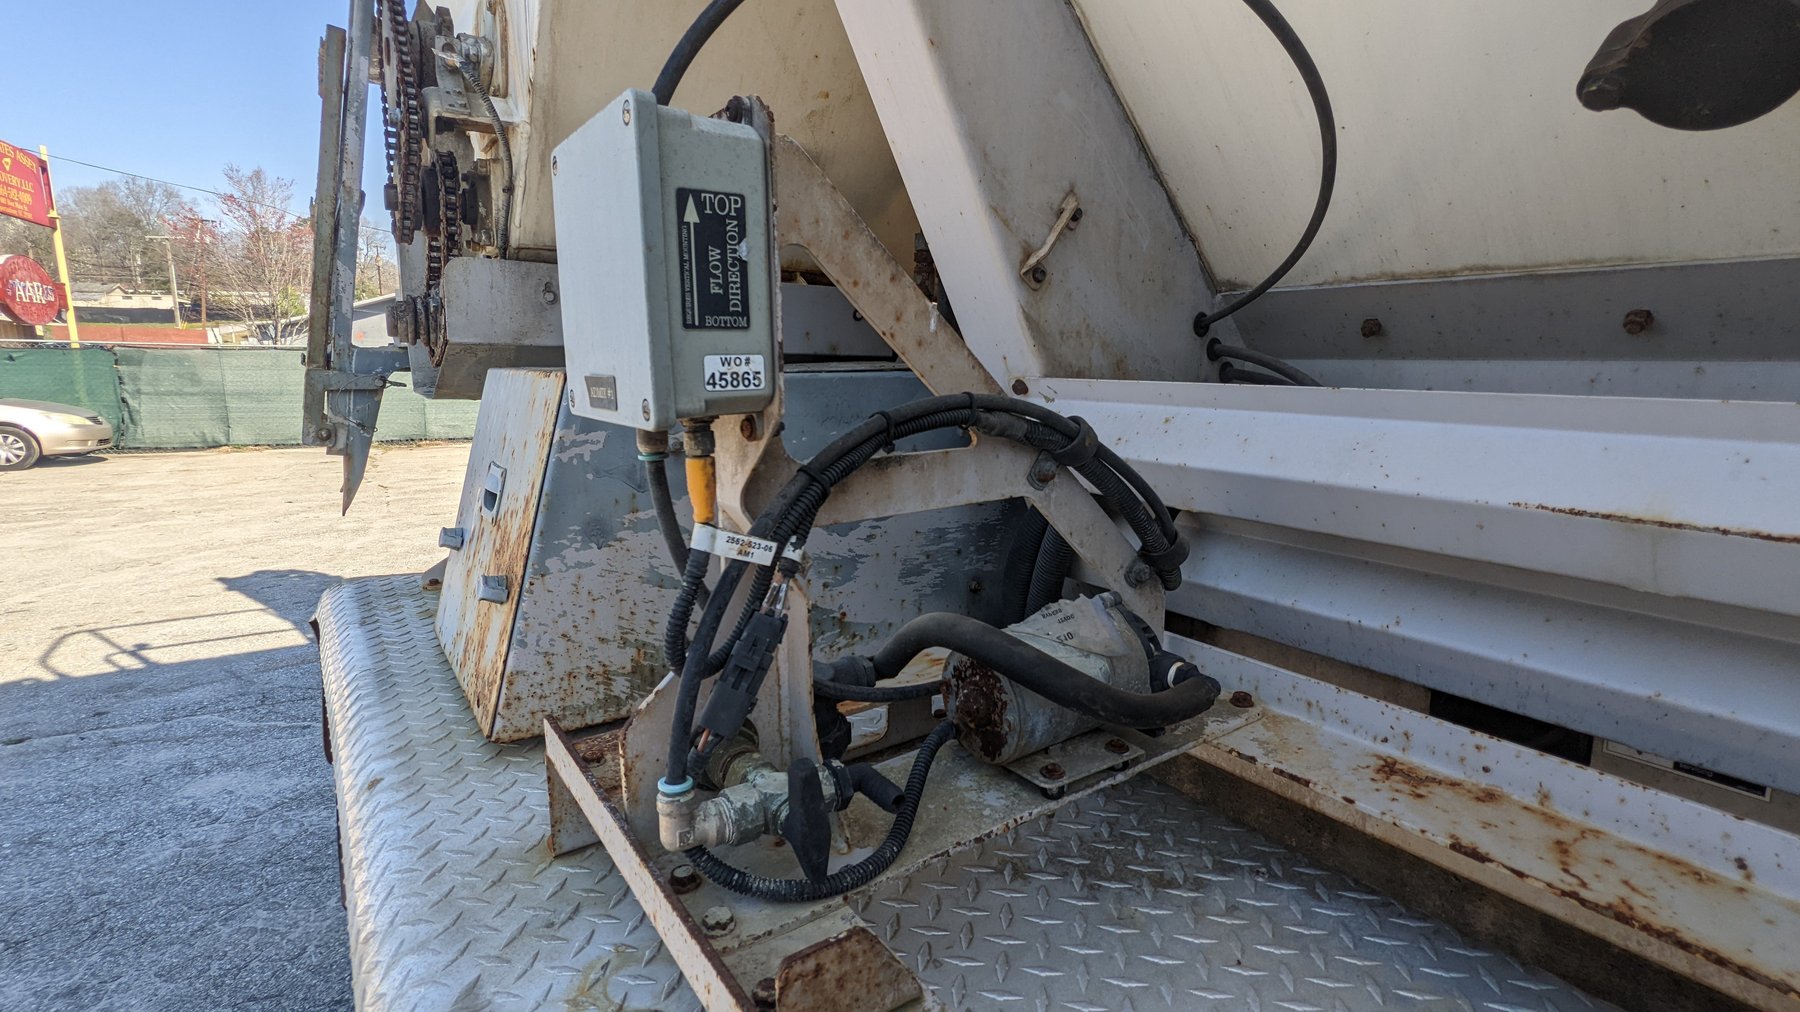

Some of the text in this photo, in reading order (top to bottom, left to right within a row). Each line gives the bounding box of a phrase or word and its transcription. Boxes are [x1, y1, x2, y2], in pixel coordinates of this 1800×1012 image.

[16, 150, 37, 174] ASSET
[702, 193, 741, 216] TOP
[681, 225, 689, 260] MOUNTING
[683, 262, 691, 292] VERTICAL
[708, 245, 723, 295] FLOW
[726, 219, 742, 312] DIRECTION
[705, 315, 748, 327] BOTTOM
[706, 371, 762, 389] 45865
